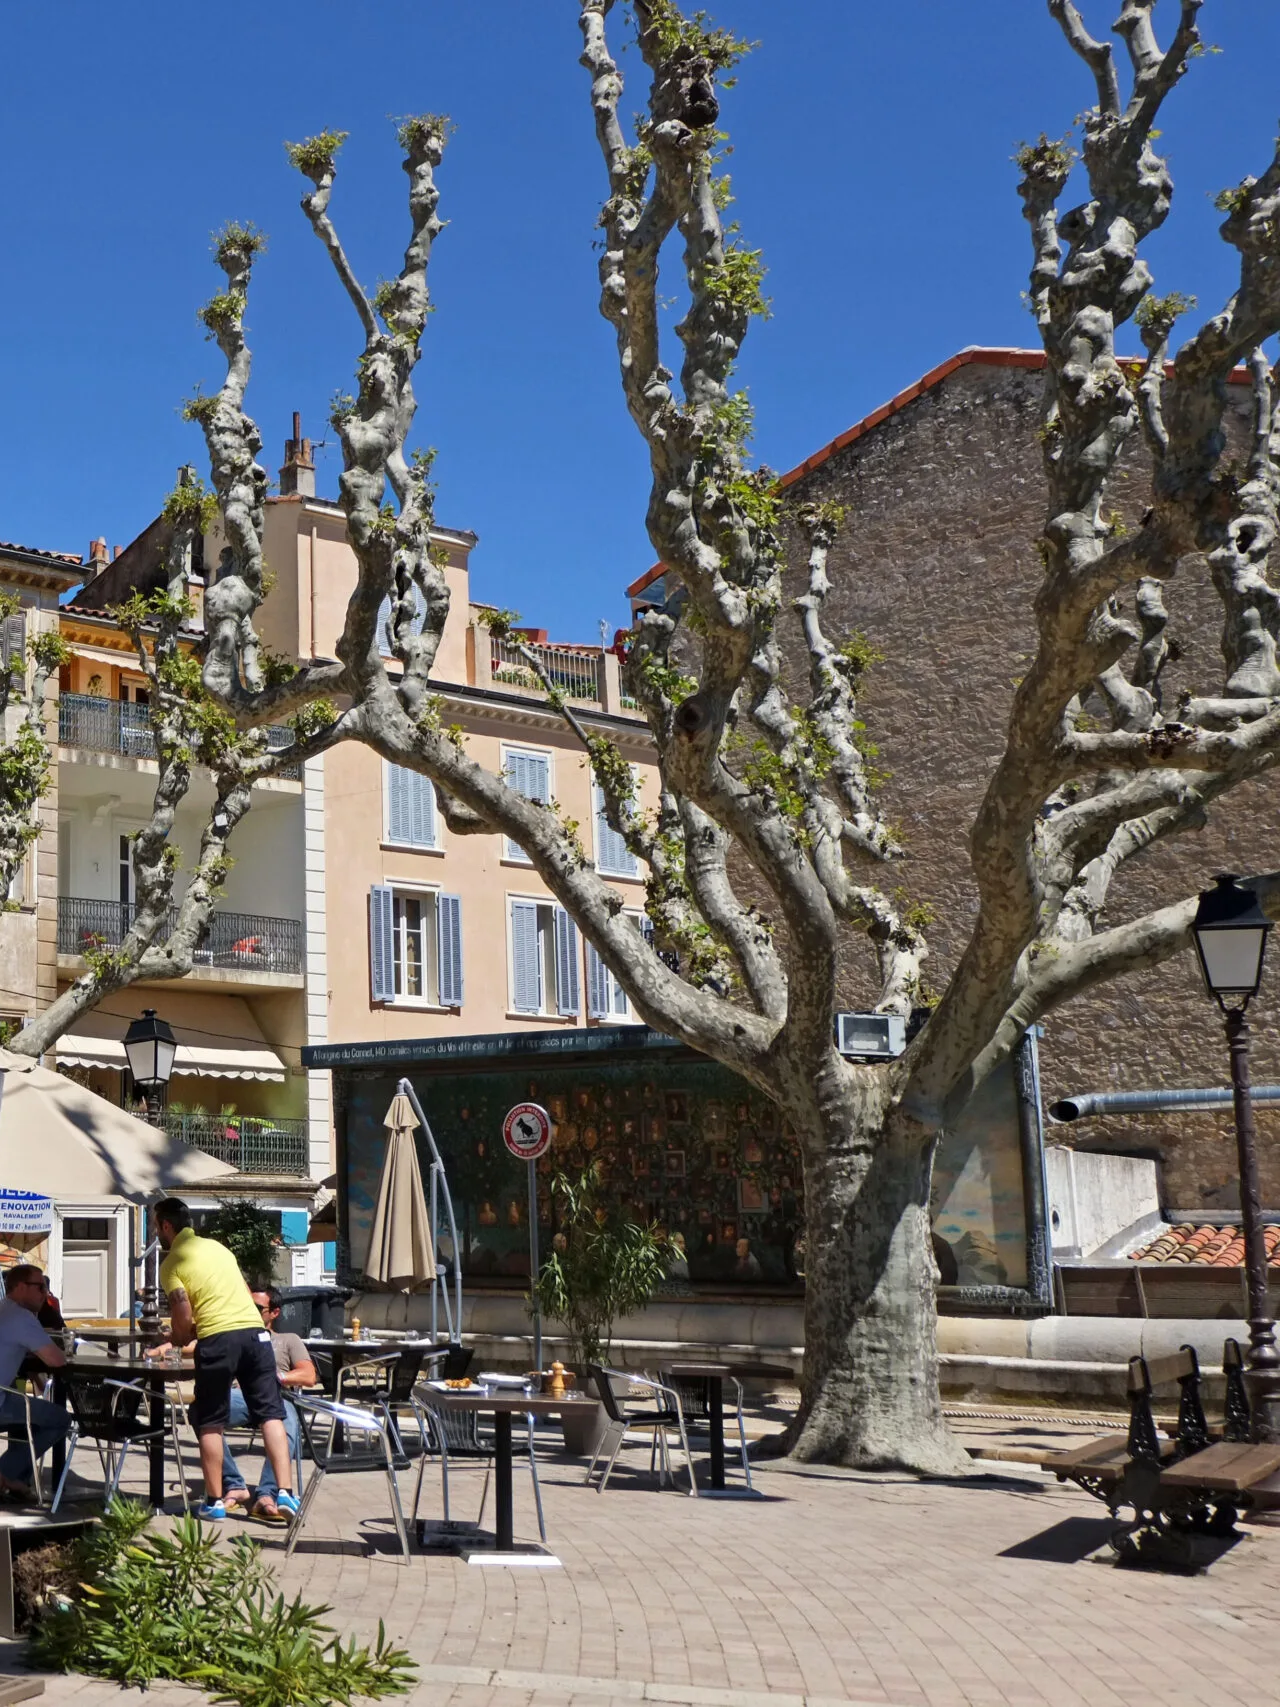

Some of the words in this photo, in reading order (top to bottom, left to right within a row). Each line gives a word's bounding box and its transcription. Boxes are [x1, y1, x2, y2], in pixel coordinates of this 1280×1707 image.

[342, 1049, 351, 1058] du
[375, 1046, 387, 1056] 140
[437, 1042, 447, 1053] du
